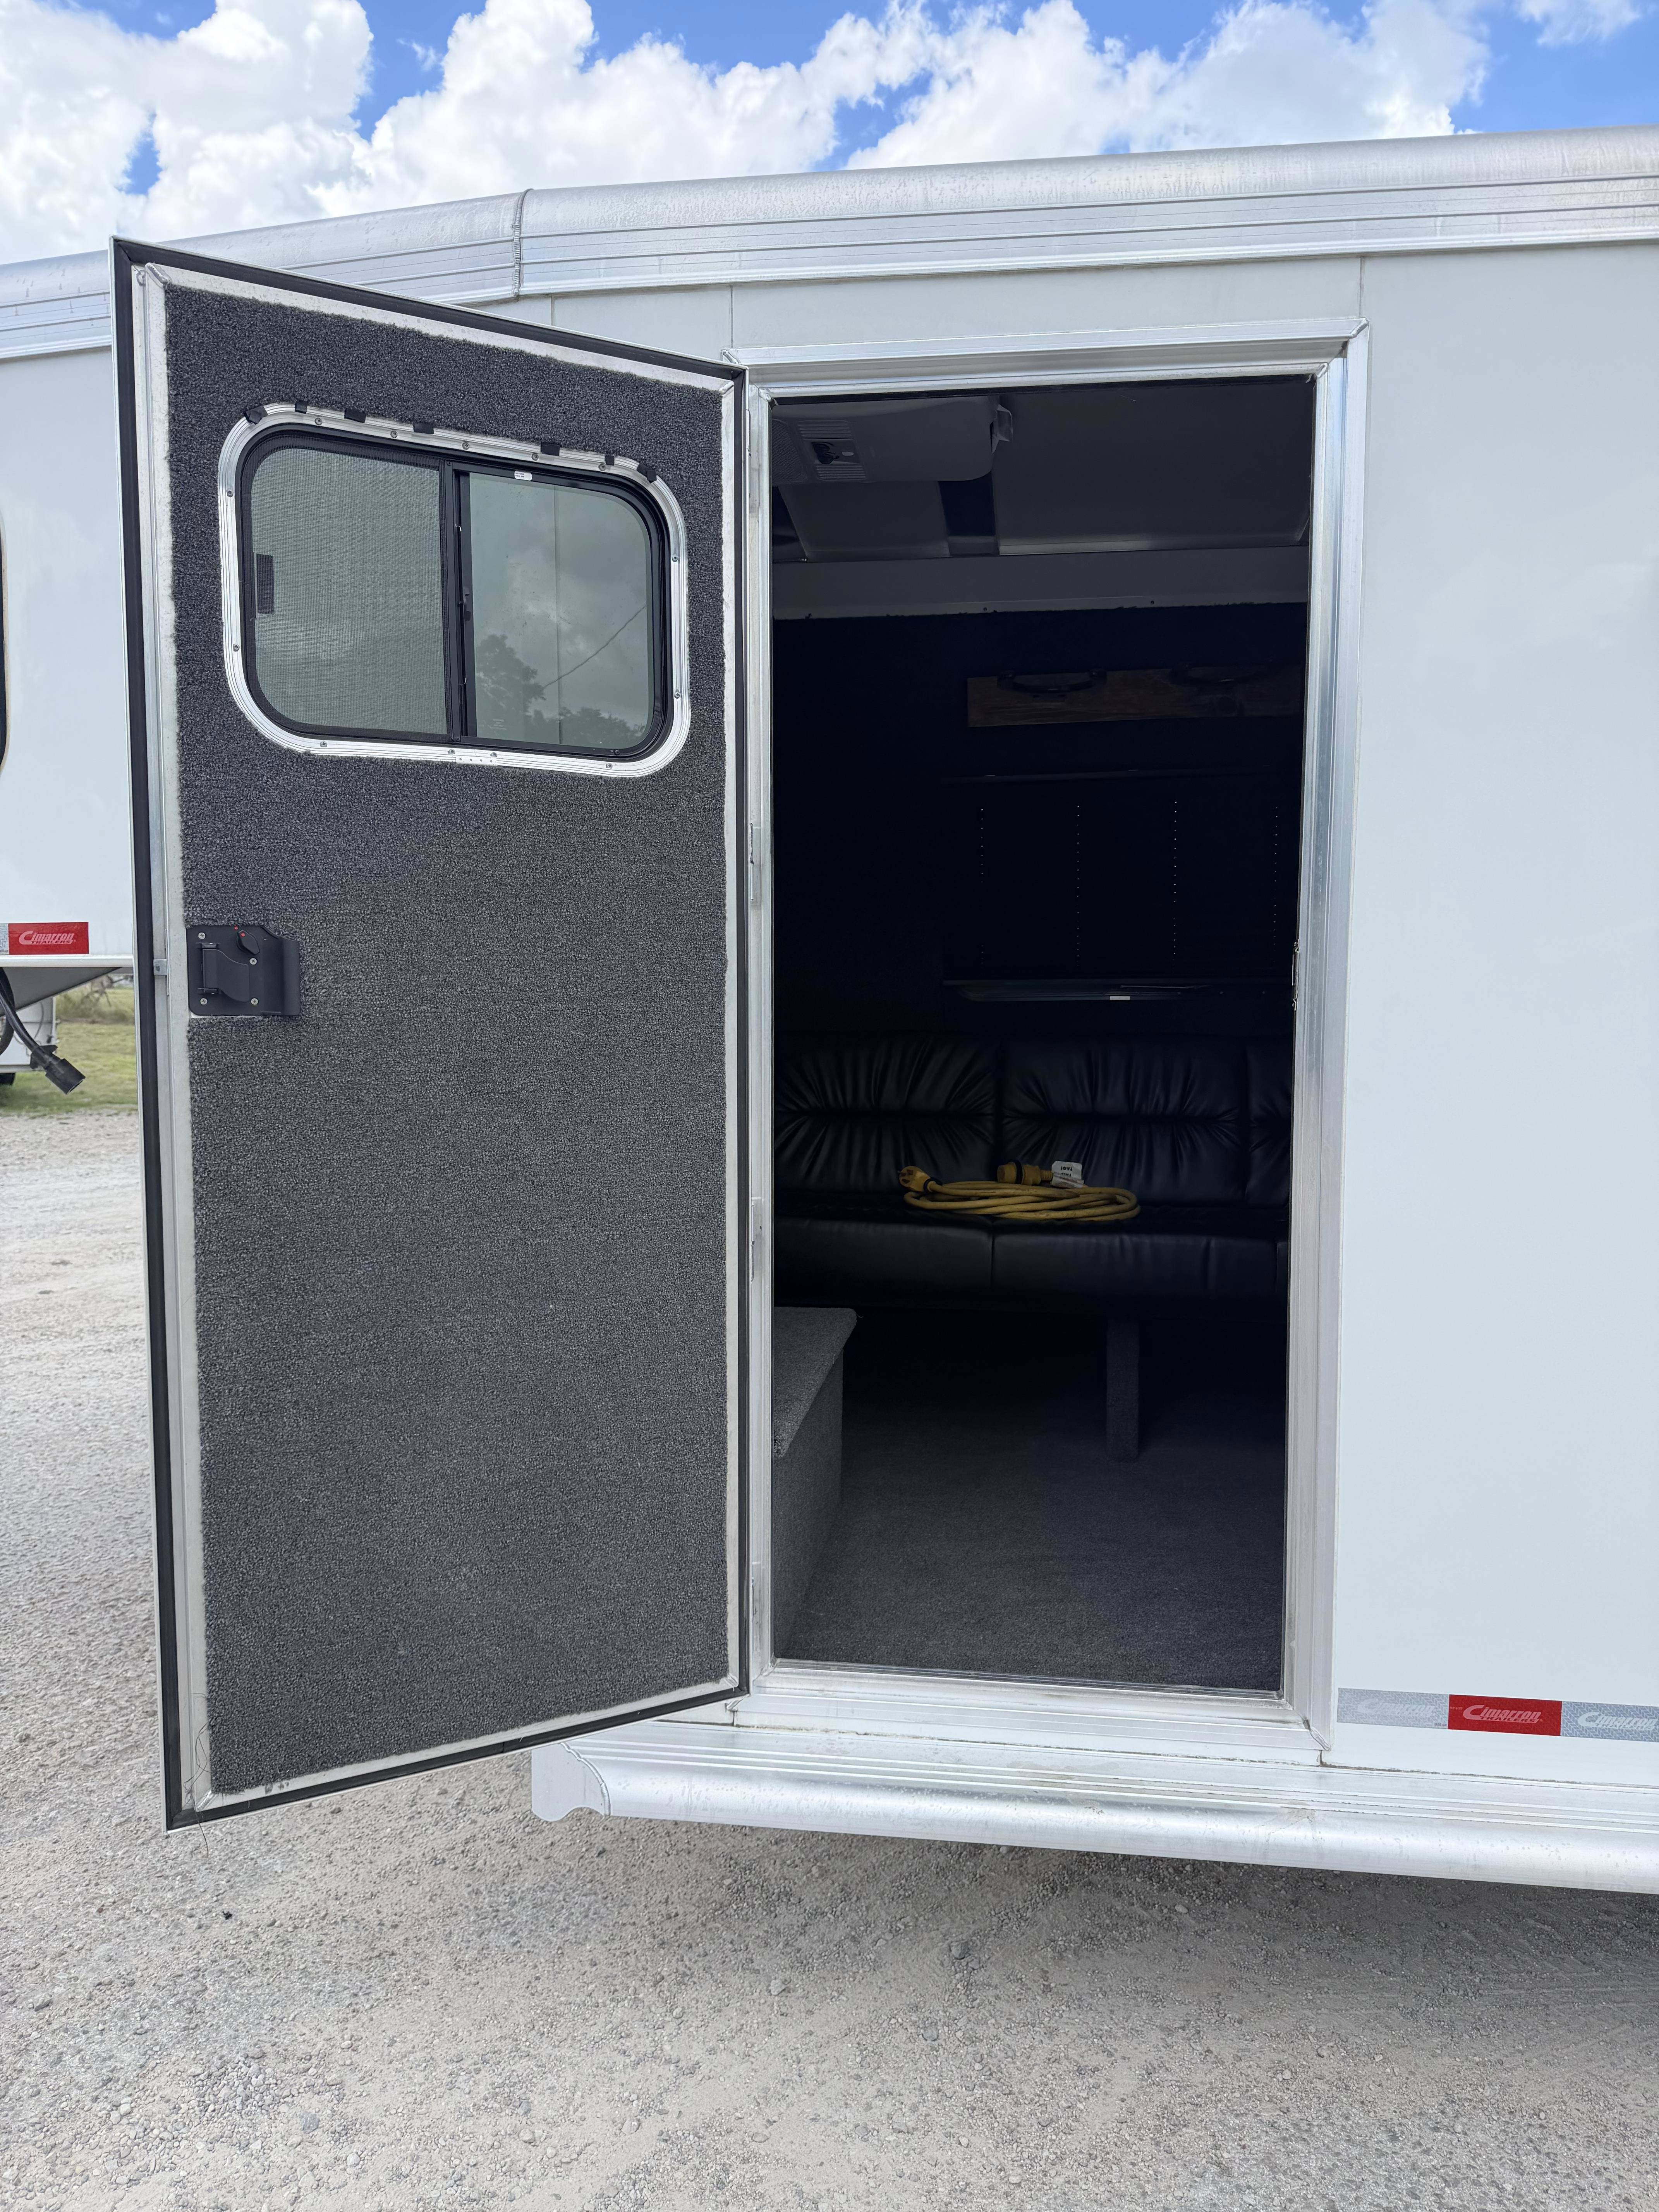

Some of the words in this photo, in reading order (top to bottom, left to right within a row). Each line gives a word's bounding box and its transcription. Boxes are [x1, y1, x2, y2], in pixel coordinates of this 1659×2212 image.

[19, 931, 75, 945] Cimarron
[1463, 1705, 1542, 1721] Cimarron
[1578, 1712, 1658, 1728] Cimarron
